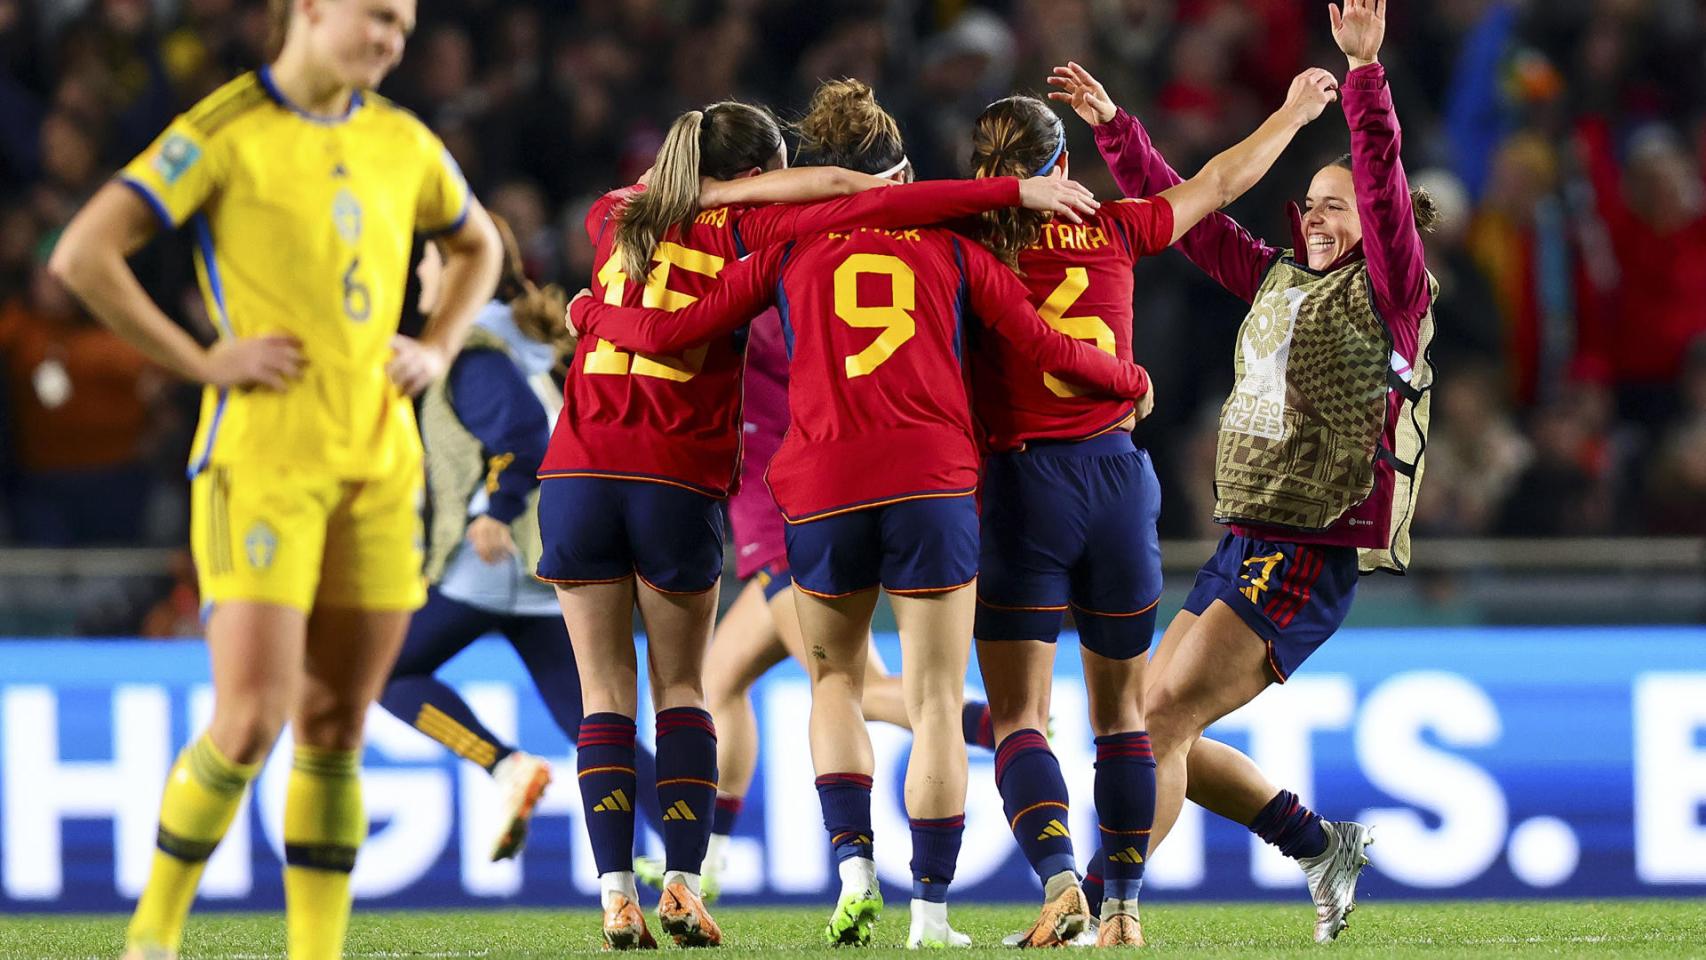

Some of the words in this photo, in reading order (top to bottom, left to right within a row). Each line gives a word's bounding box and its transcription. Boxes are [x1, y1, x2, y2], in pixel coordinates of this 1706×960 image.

[342, 256, 371, 323] 6
[1024, 223, 1109, 250] TANA
[583, 241, 725, 383] 15
[833, 253, 916, 379] 9
[1036, 267, 1117, 398] 6
[3, 670, 1580, 899] HGHIGHTS.
